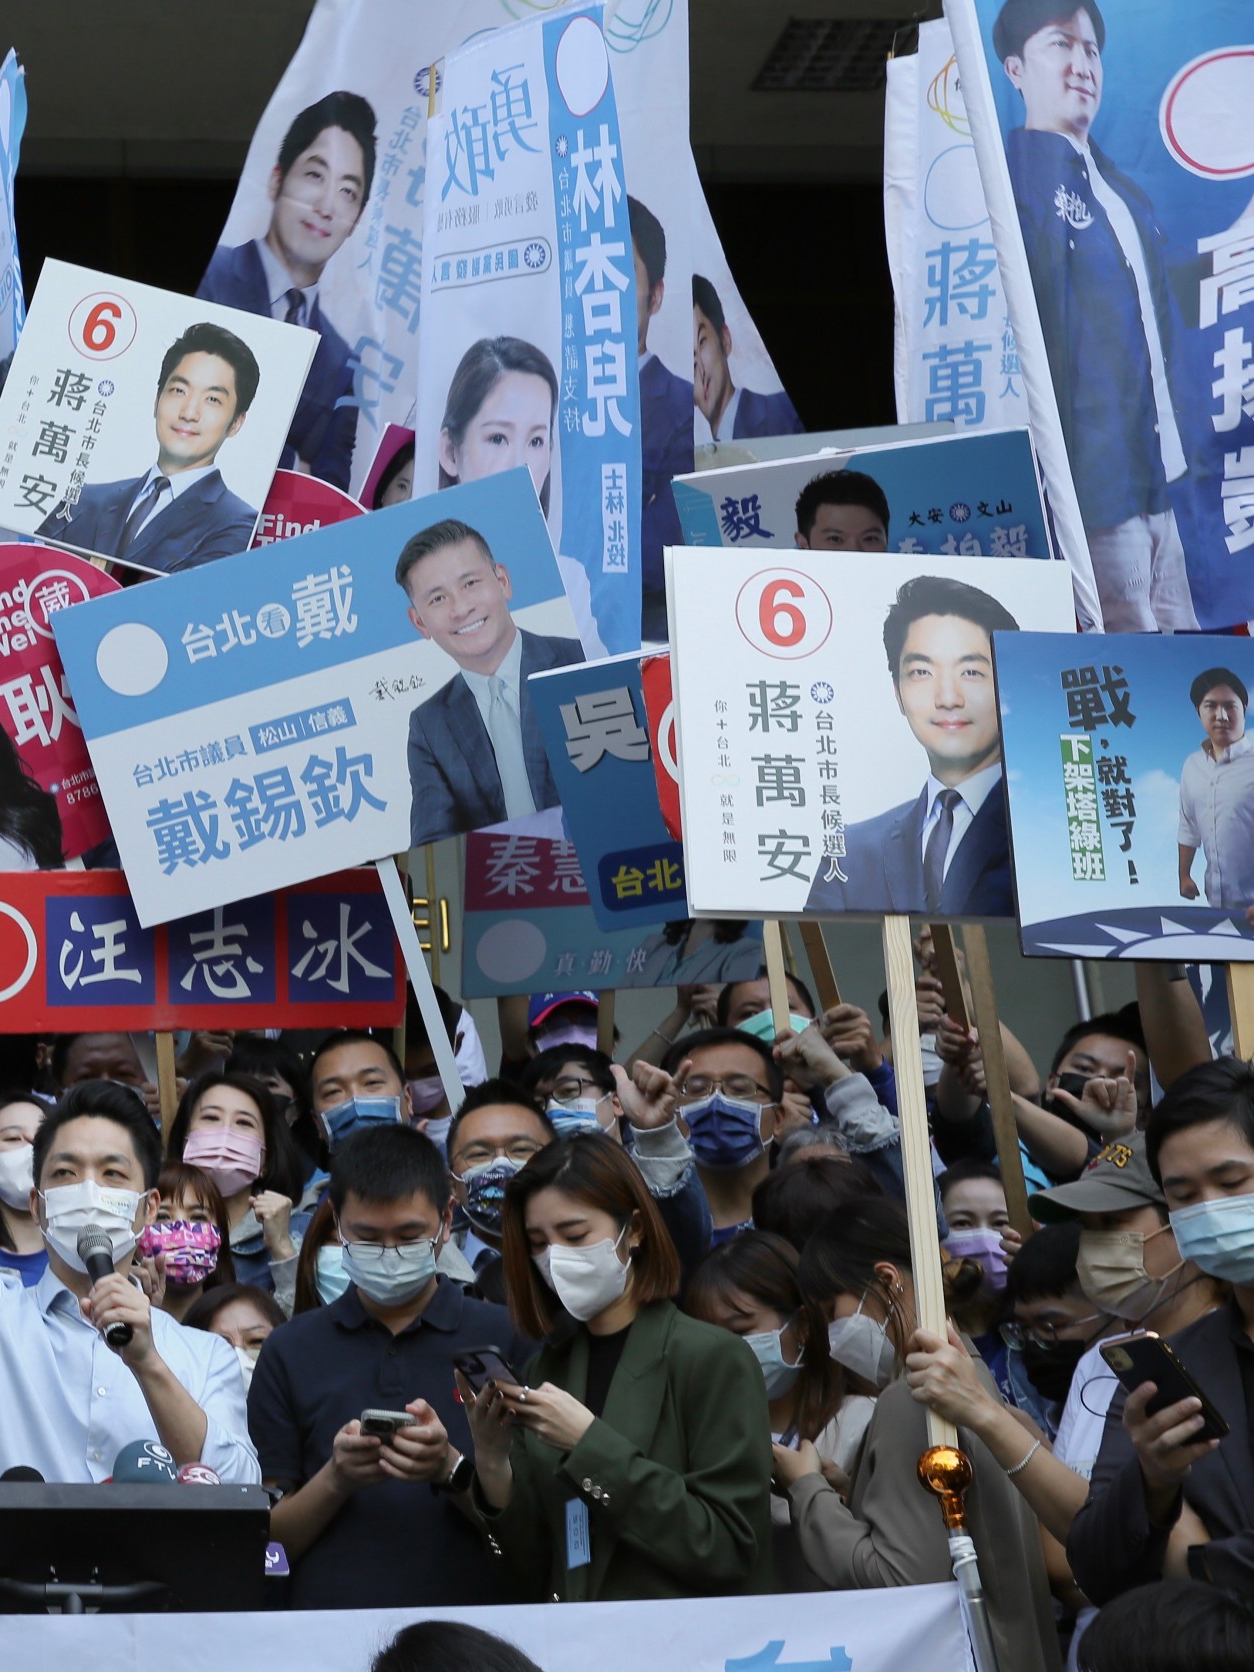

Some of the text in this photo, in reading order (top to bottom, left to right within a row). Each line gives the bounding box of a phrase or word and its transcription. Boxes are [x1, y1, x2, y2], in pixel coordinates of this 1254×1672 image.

[82, 301, 122, 352] 6
[14, 367, 94, 517] 蔣萬安
[55, 399, 108, 523] 台北市長候選人
[258, 514, 321, 539] Find
[757, 579, 807, 648] 6
[132, 734, 249, 788] 台北市議員
[558, 686, 650, 774] 吳
[145, 745, 389, 877] 戴錫欽
[719, 793, 738, 864] 就是無限
[746, 680, 813, 886] 蔣萬安
[815, 710, 849, 884] 台北市長候選人
[1060, 734, 1105, 881] 下架塔綠班
[611, 858, 682, 899] 台北
[58, 902, 393, 999] 汪志冰
